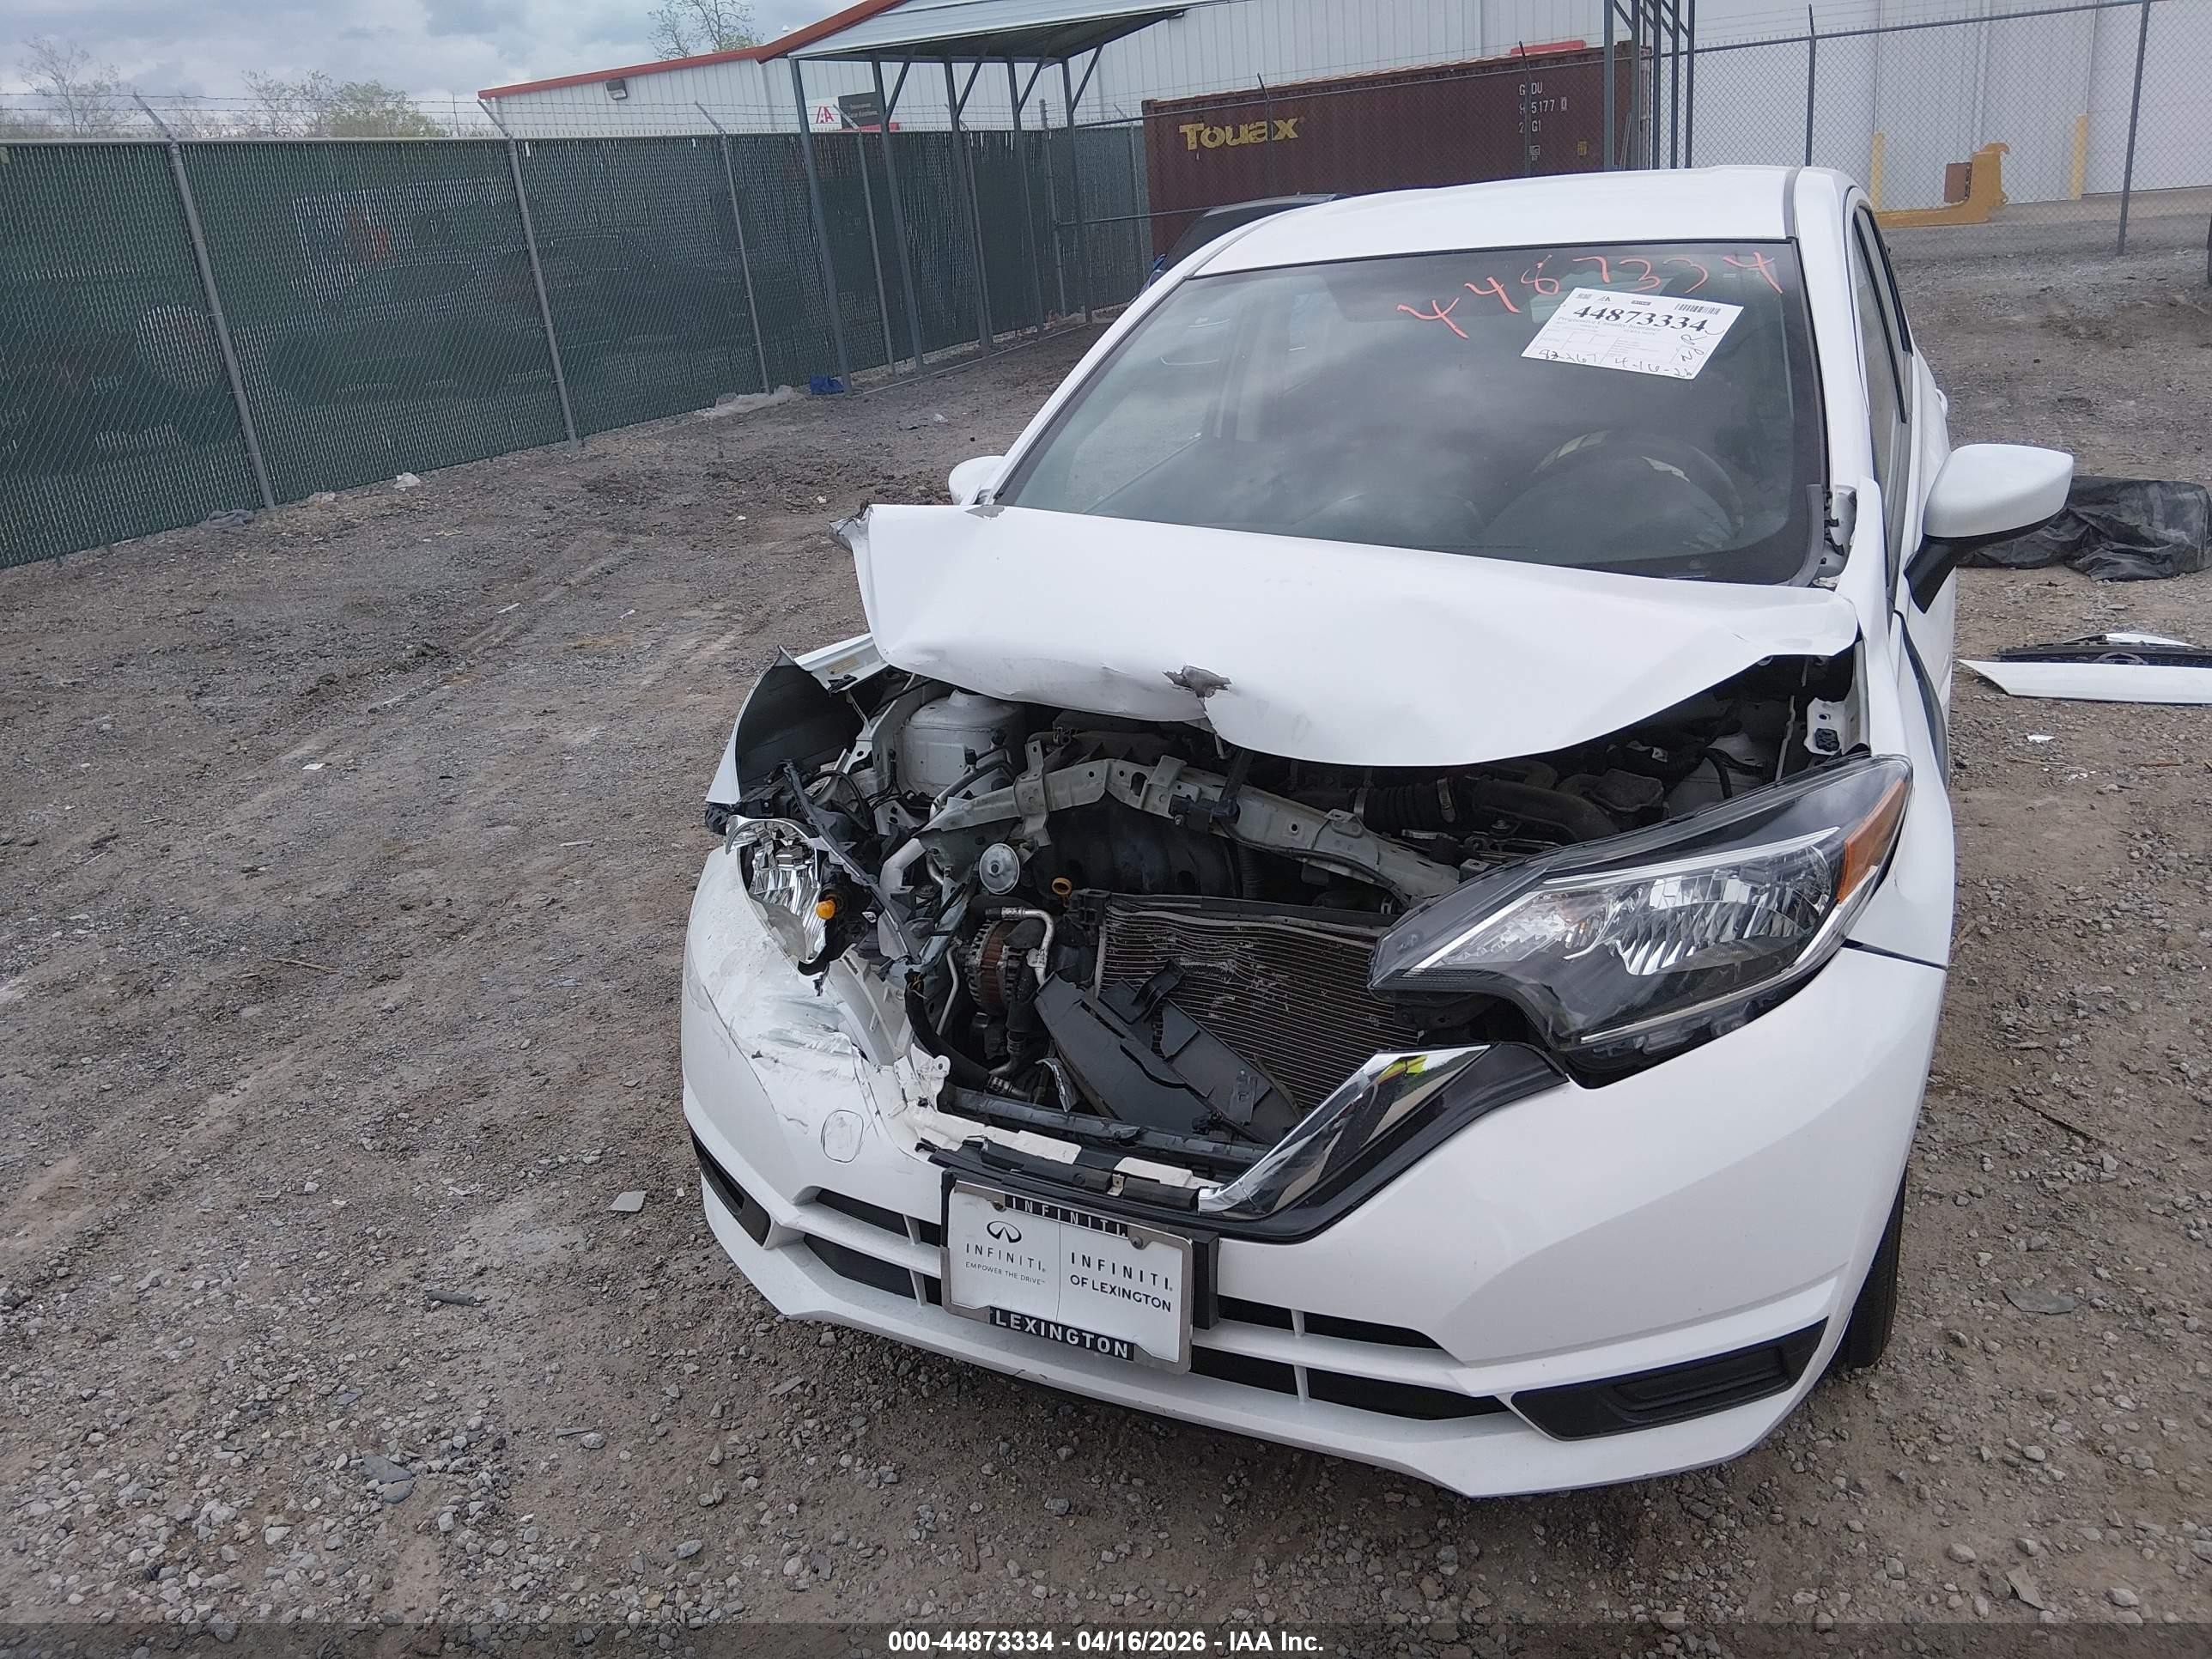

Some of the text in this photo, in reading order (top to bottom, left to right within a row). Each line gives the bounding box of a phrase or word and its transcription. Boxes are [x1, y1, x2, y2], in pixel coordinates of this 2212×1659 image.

[1519, 82, 1543, 96] GDU
[1573, 306, 1708, 331] 44873334
[965, 1261, 1002, 1275] EMPOWER
[1005, 1270, 1018, 1279] THE
[1070, 1274, 1171, 1313] OF LEXINGTON
[994, 1310, 1128, 1358] LEXINGTON
